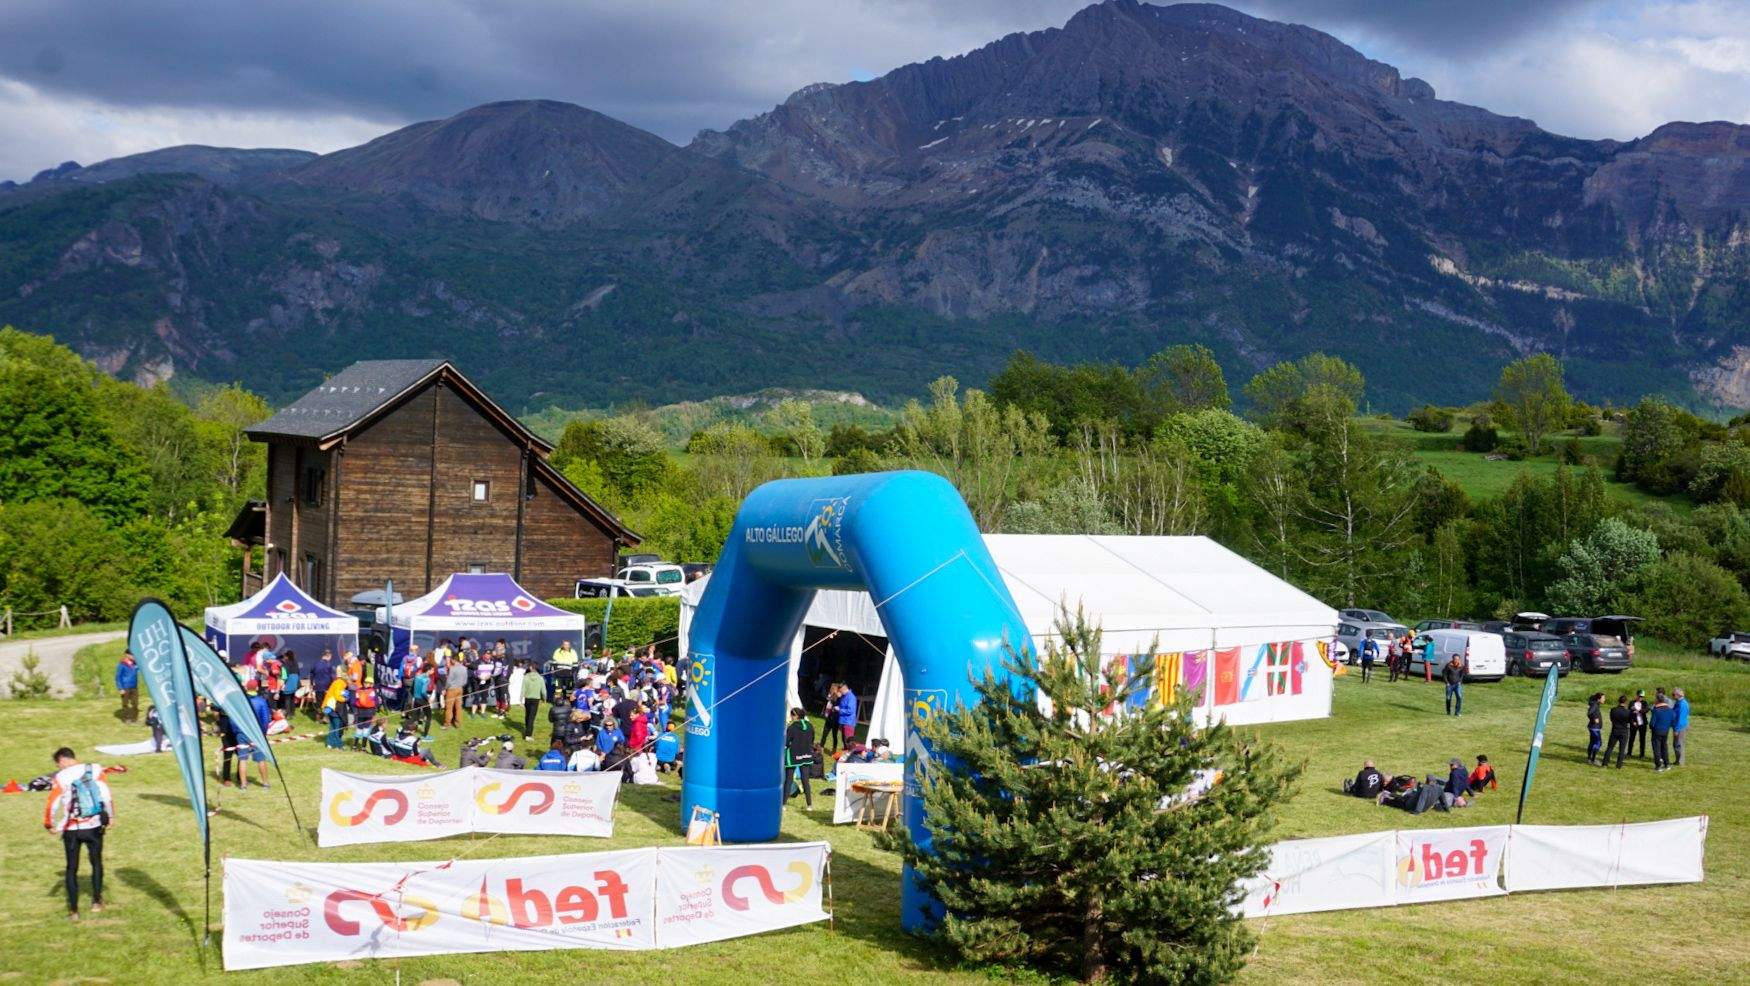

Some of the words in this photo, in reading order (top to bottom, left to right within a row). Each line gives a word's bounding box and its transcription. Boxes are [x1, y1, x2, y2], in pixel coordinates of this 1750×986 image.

[745, 527, 765, 543] ALTO
[765, 523, 804, 544] GÁLLEGO
[256, 622, 291, 631] OUTDOOR
[292, 622, 306, 631] FOR
[306, 622, 331, 631] LIVING
